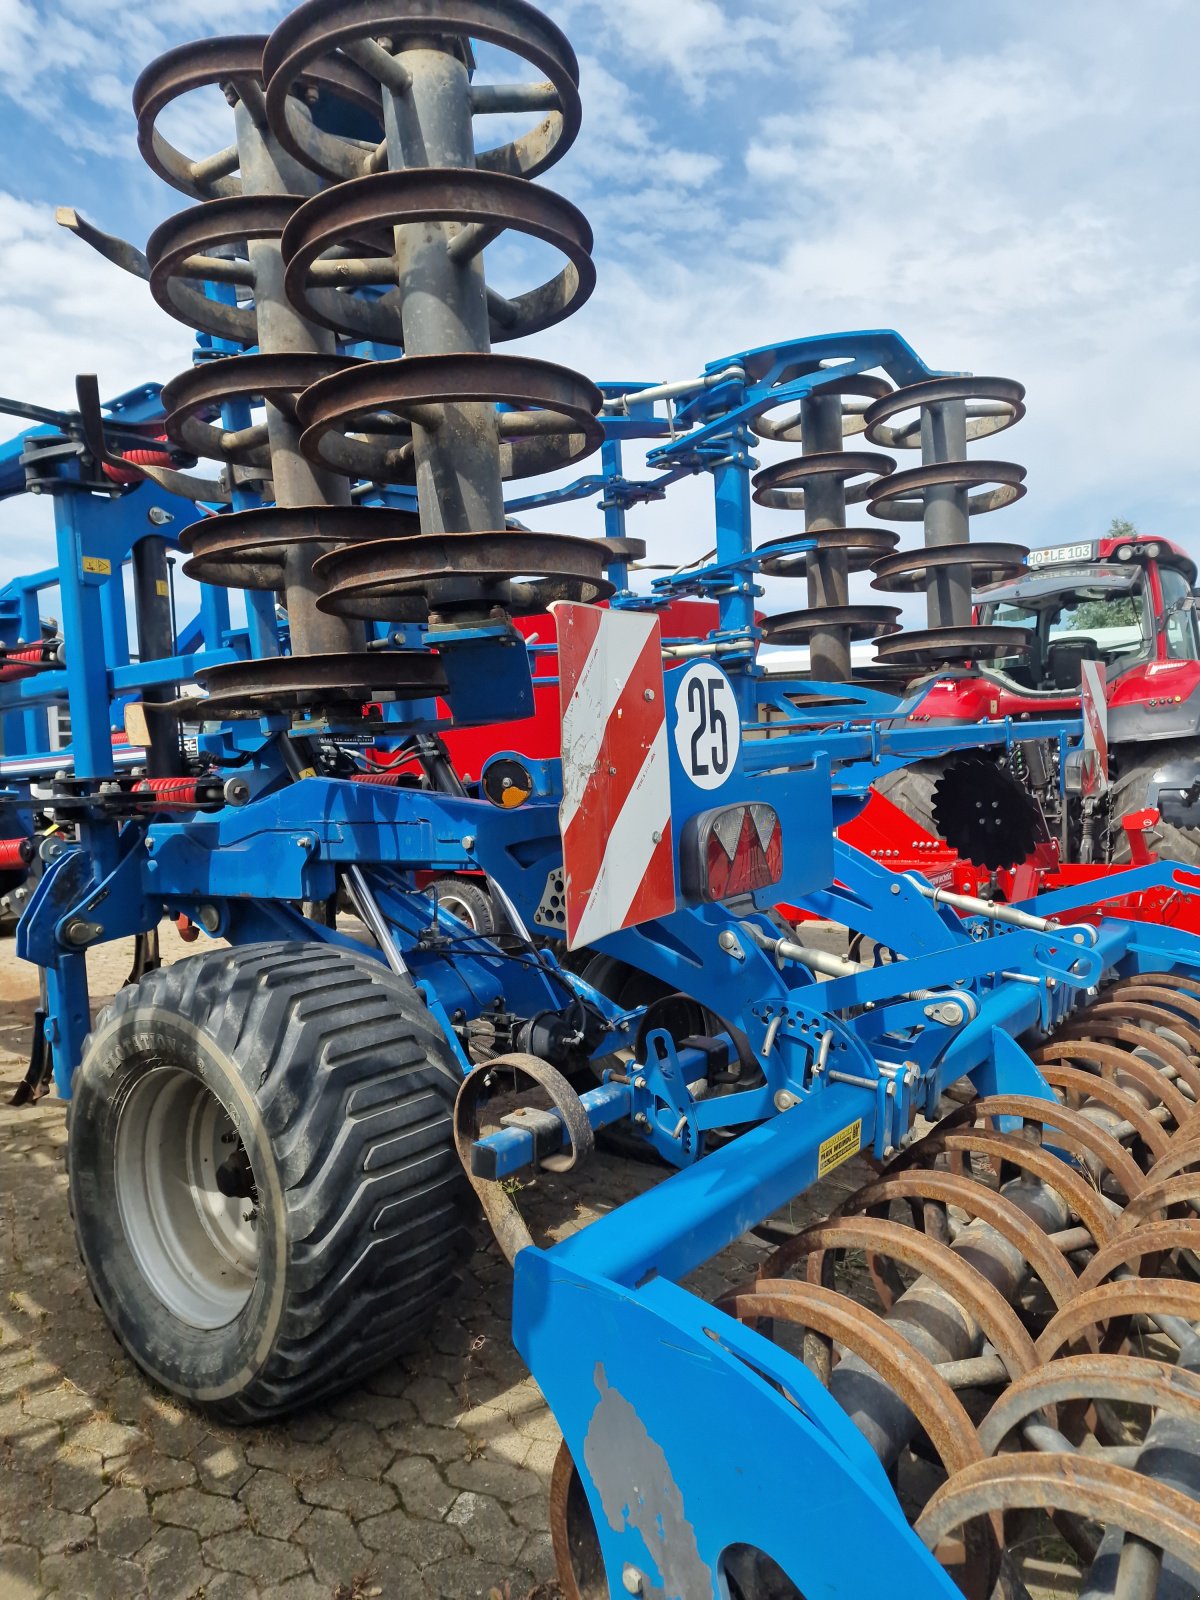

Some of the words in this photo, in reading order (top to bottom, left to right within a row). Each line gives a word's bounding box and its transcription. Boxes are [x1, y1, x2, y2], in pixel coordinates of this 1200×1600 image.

[1028, 552, 1043, 565] HO
[1050, 548, 1066, 561] LE
[1067, 545, 1090, 559] 103
[687, 676, 729, 777] 25
